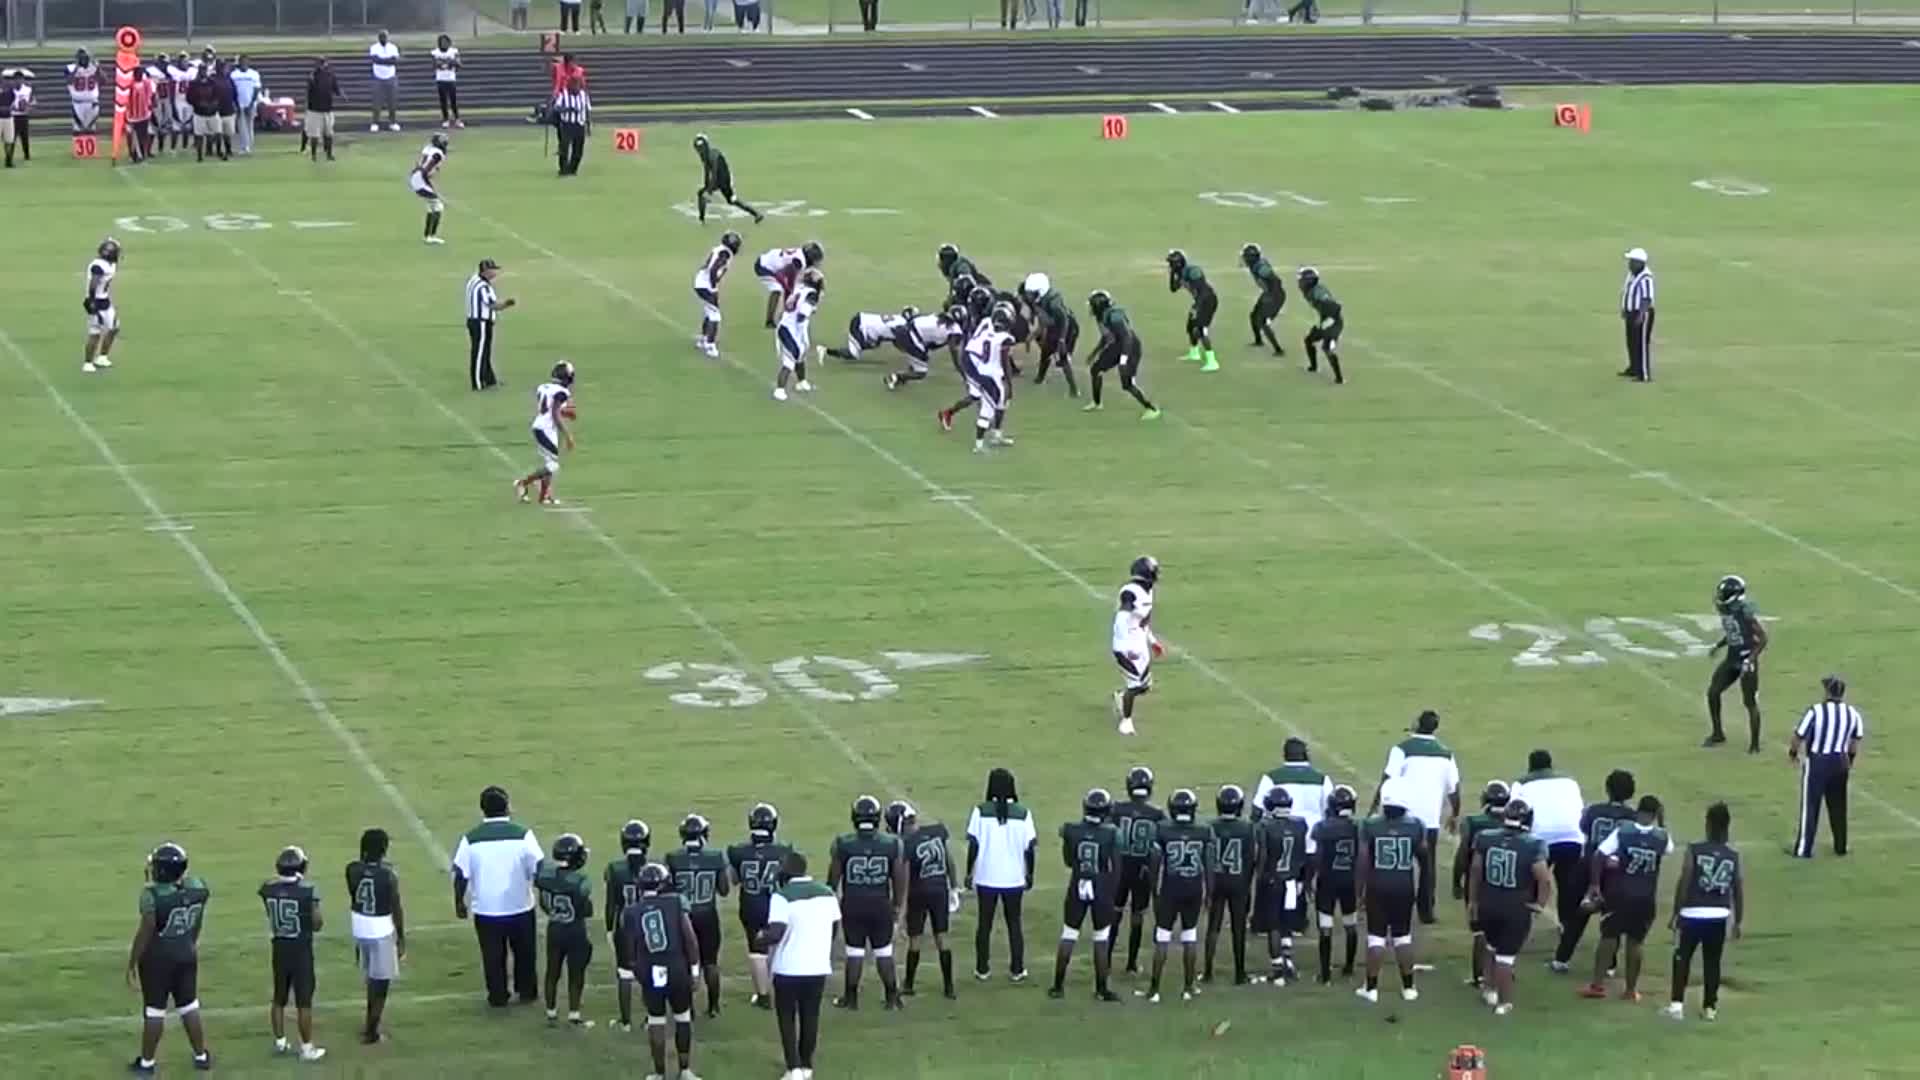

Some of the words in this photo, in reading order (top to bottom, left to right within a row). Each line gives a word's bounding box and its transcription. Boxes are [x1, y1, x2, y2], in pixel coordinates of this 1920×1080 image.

[1468, 617, 1718, 666] 20
[643, 655, 900, 707] 30
[1486, 847, 1518, 889] 61
[355, 878, 377, 915] 4
[266, 898, 301, 938] 15
[641, 910, 669, 953] 8
